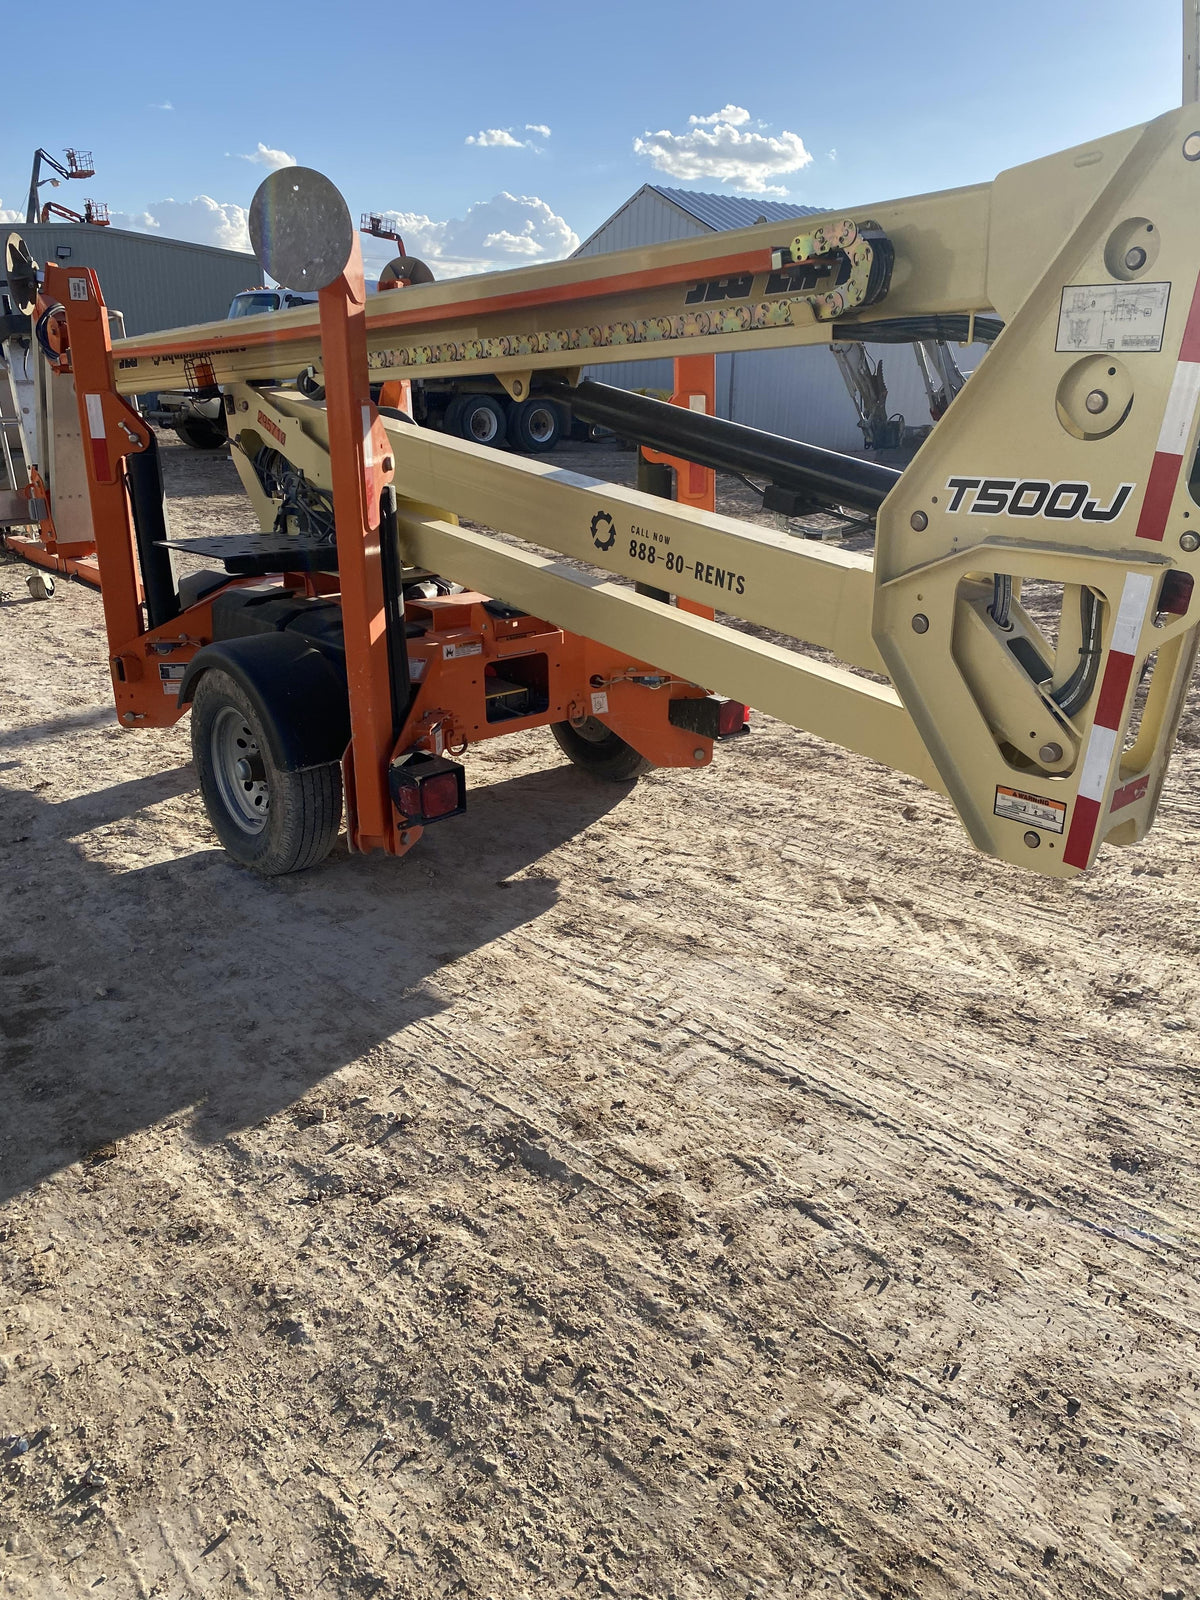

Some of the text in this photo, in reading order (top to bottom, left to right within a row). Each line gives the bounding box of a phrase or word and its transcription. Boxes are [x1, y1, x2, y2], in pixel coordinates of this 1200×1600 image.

[946, 477, 1134, 522] T500J
[630, 525, 671, 545] CALL NOW
[628, 539, 746, 595] 888-80-RENTS
[1018, 793, 1050, 806] WARNING
